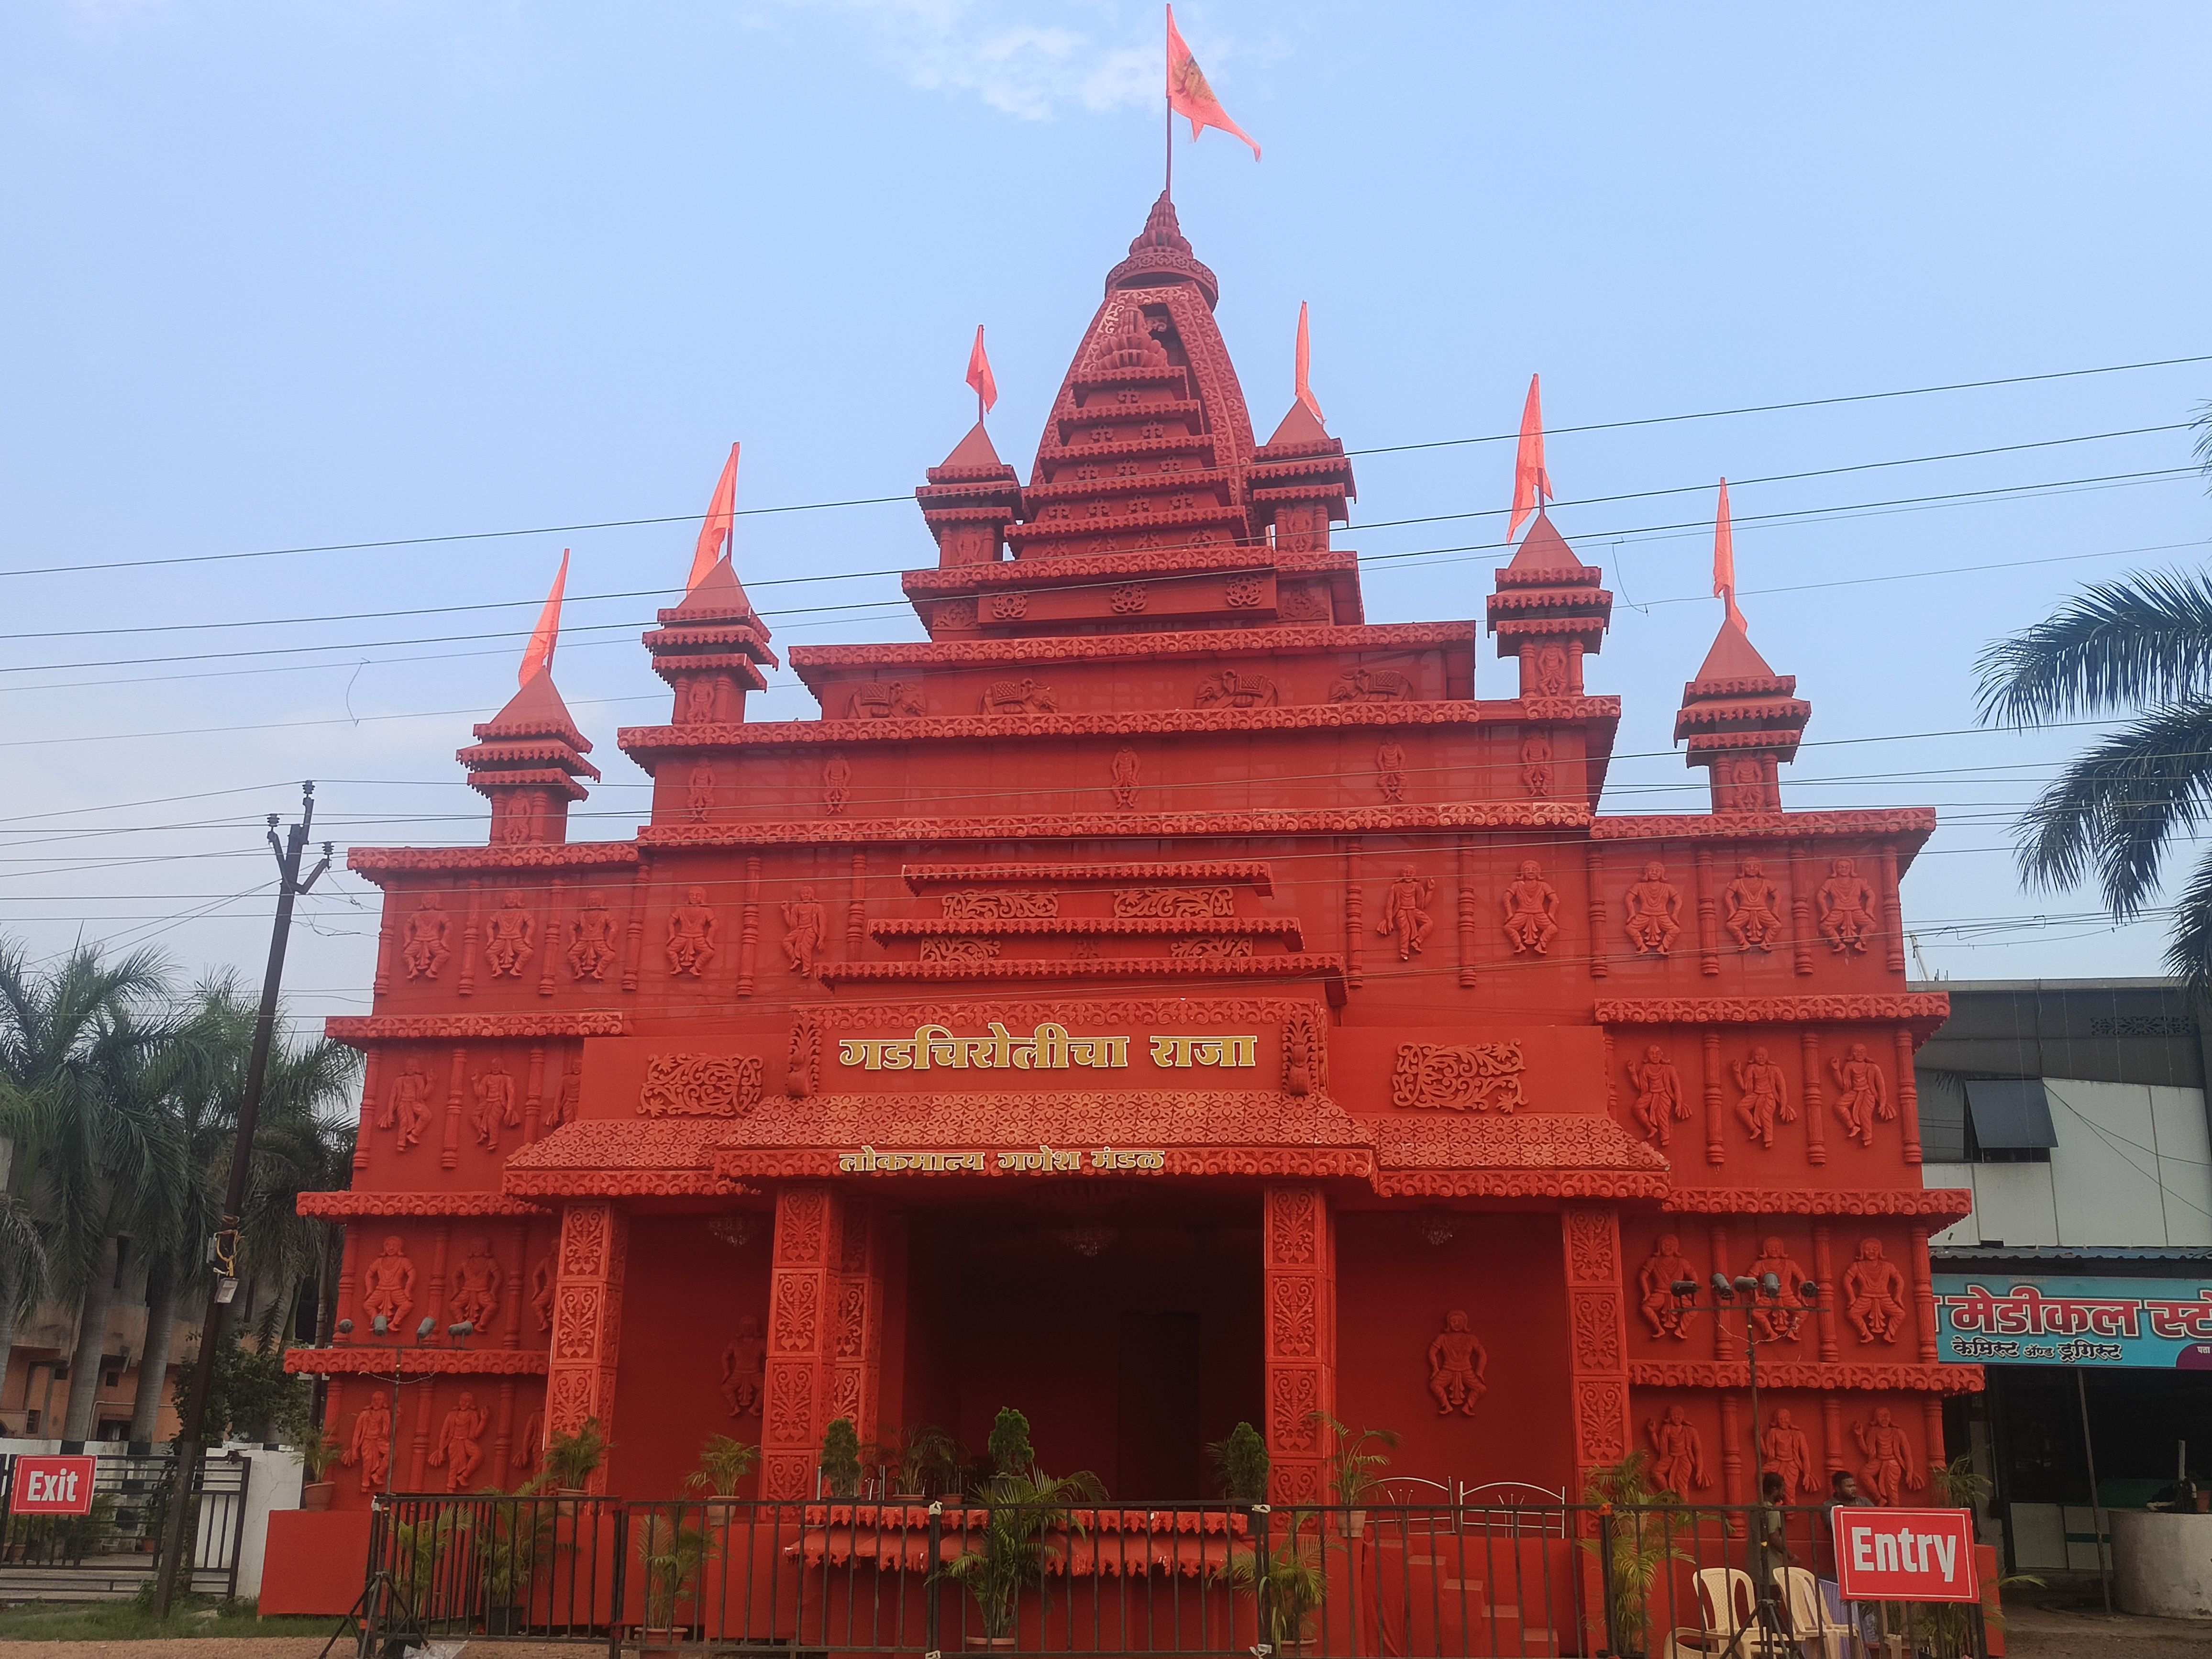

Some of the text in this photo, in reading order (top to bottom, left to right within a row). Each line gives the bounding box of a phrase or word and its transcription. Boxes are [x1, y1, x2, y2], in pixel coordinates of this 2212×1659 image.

[839, 1022, 1257, 1070] गडचिरोलीचा राजा
[839, 1145, 1165, 1171] लोकमान्य गणेश मंडळ
[1945, 1285, 2142, 1337] मेडीकल
[1951, 1335, 2019, 1358] केमिस्ट
[2057, 1338, 2123, 1362] ड्रगिस्ट
[27, 1468, 78, 1502] Exit
[1851, 1527, 1956, 1582] Entry
